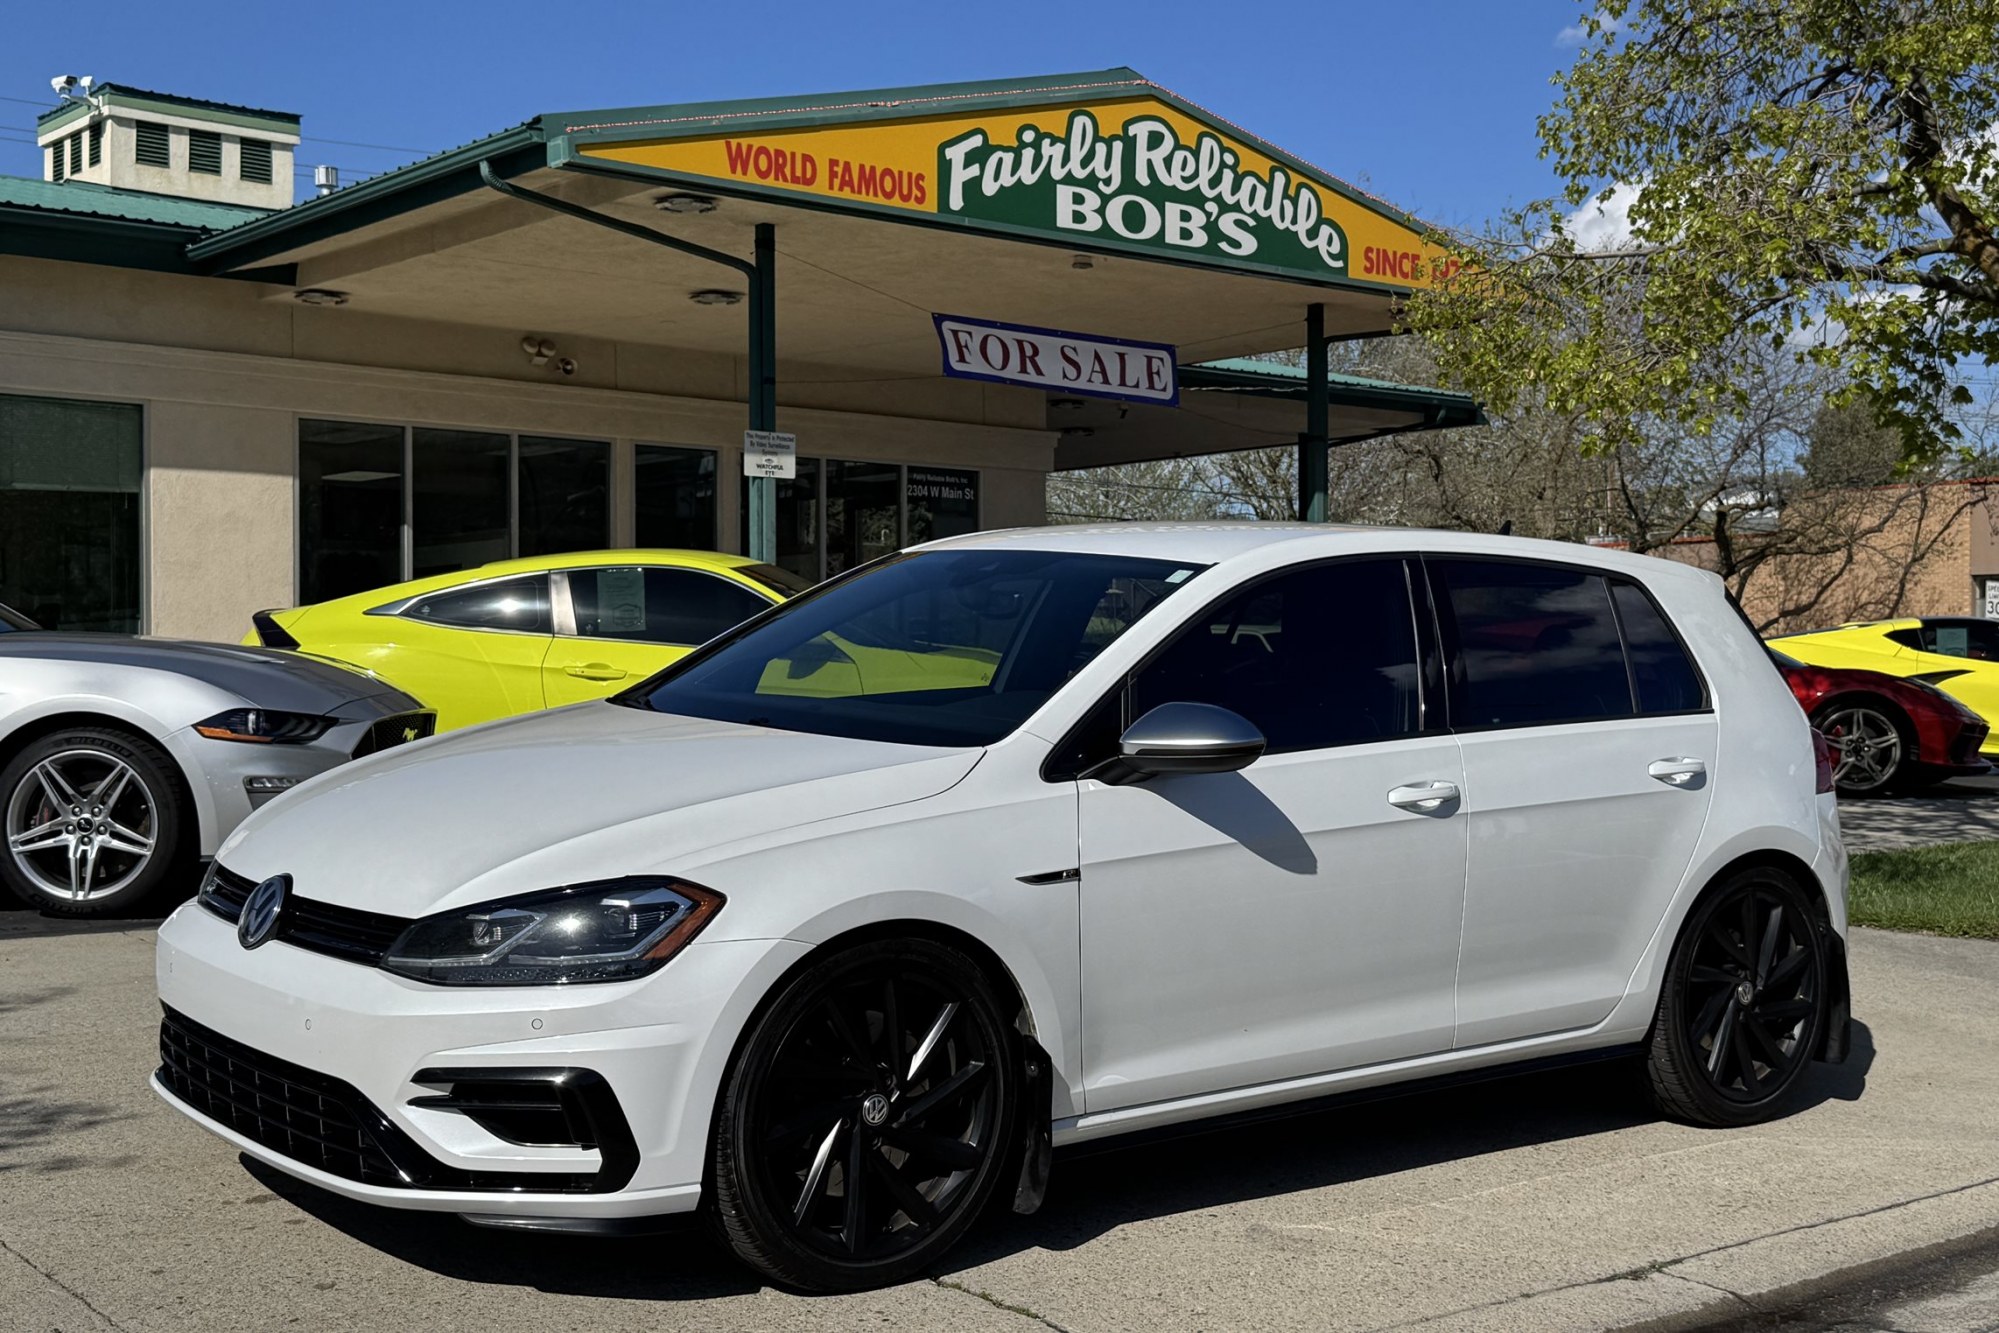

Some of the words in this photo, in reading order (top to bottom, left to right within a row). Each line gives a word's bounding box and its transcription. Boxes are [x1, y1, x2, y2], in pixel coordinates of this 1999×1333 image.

[725, 140, 817, 187] WORLD
[828, 158, 926, 205] FAMOUS
[945, 114, 1123, 211] Fairly
[1128, 120, 1344, 267] Reliable
[1056, 183, 1259, 256] BOB'S
[1363, 246, 1420, 281] SINCE
[948, 328, 1045, 376] FOR
[1059, 345, 1168, 392] SALE
[908, 485, 928, 497] 2304
[930, 486, 940, 497] W
[941, 486, 962, 499] Main
[964, 488, 974, 500] St
